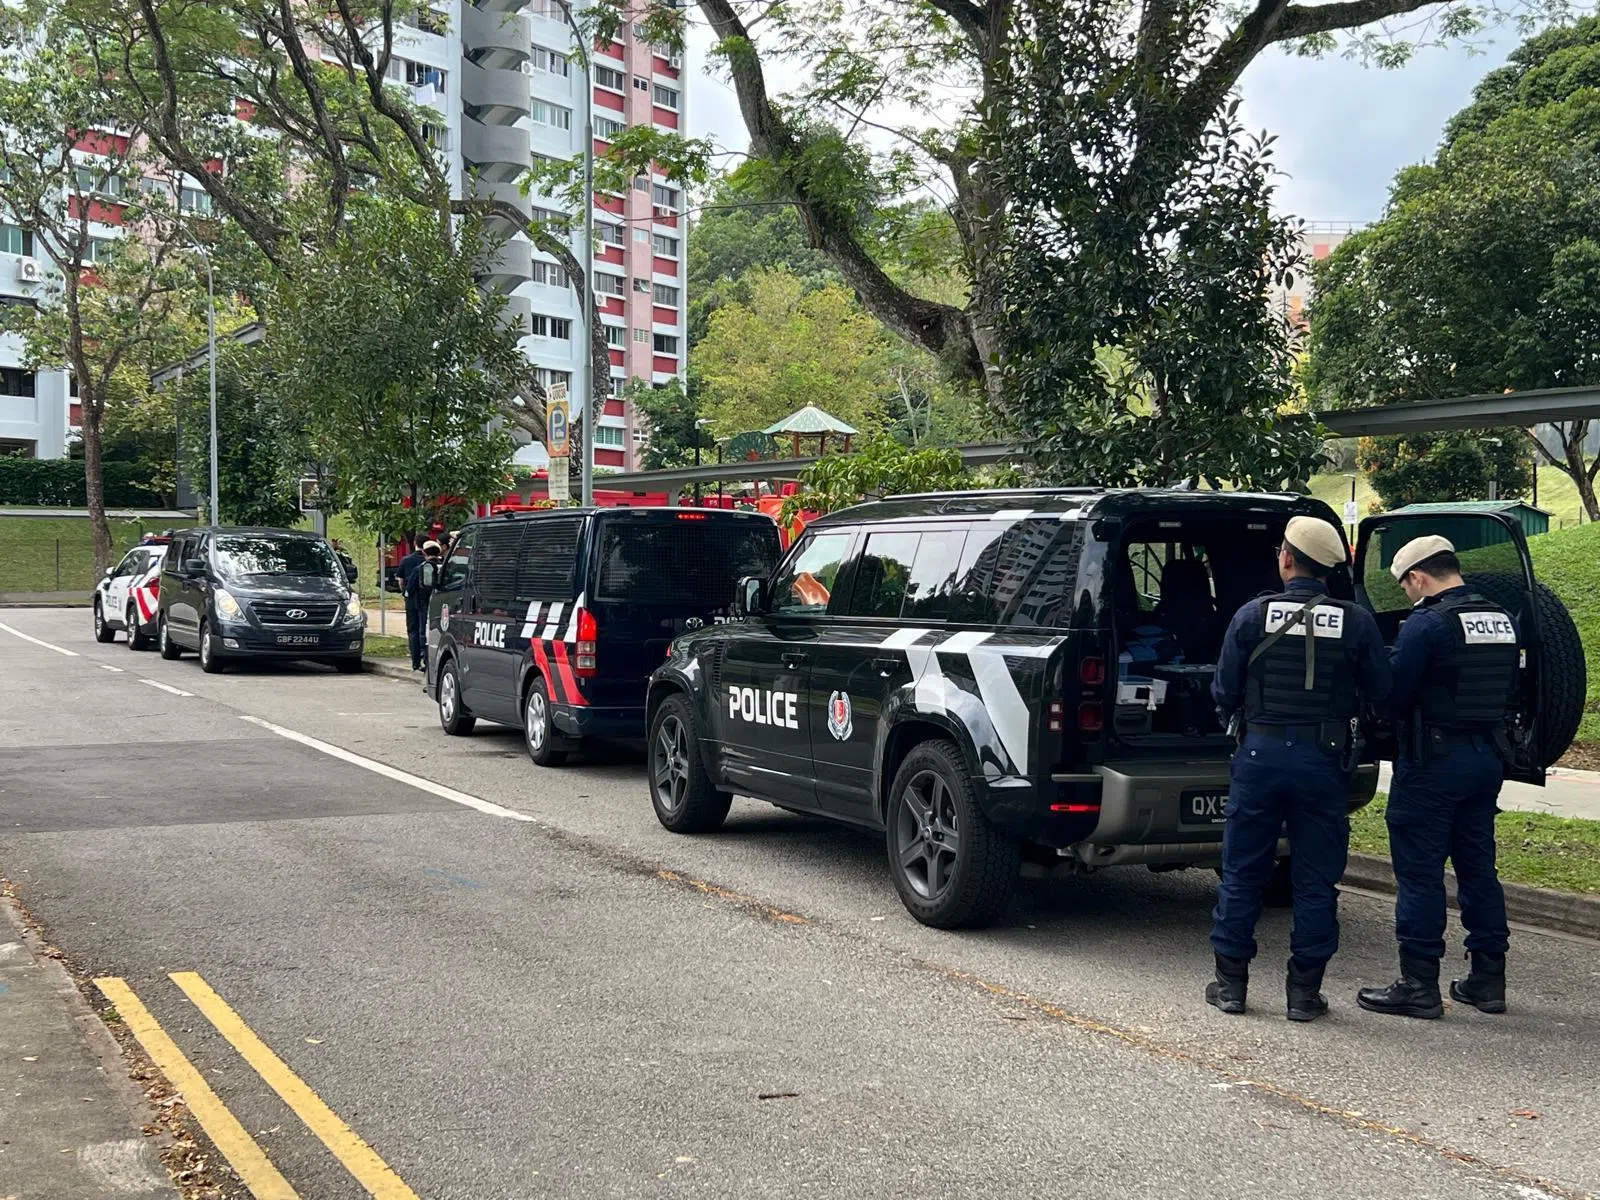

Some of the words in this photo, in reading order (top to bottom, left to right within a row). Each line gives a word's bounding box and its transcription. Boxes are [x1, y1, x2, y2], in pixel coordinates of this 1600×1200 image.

[1270, 609, 1339, 628] POCE
[1465, 620, 1512, 634] POLICE
[474, 621, 506, 648] POLICE
[728, 685, 799, 730] POLICE
